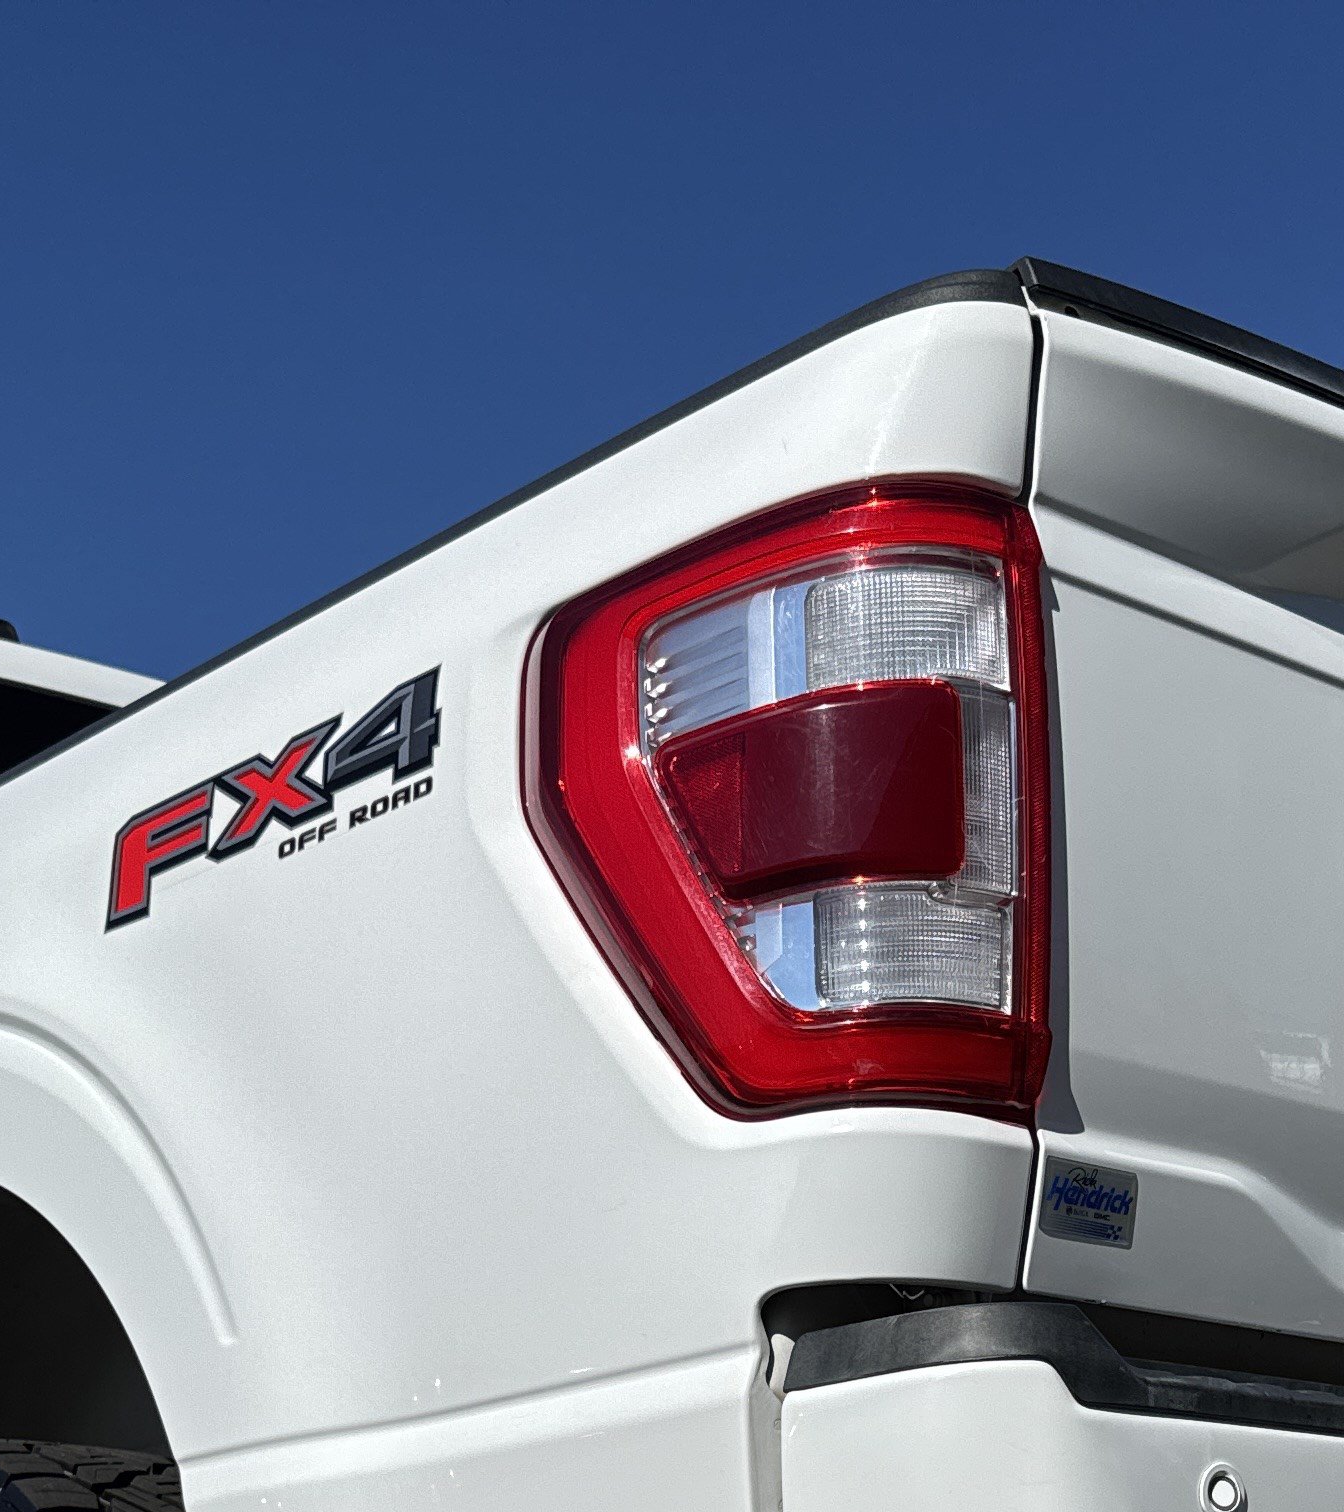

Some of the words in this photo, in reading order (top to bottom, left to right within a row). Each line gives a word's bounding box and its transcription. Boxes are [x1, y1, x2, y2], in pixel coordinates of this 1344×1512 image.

[105, 664, 442, 934] FX4
[278, 818, 337, 859] OFF
[349, 776, 434, 830] ROAD
[1046, 1176, 1133, 1215] Hendrick
